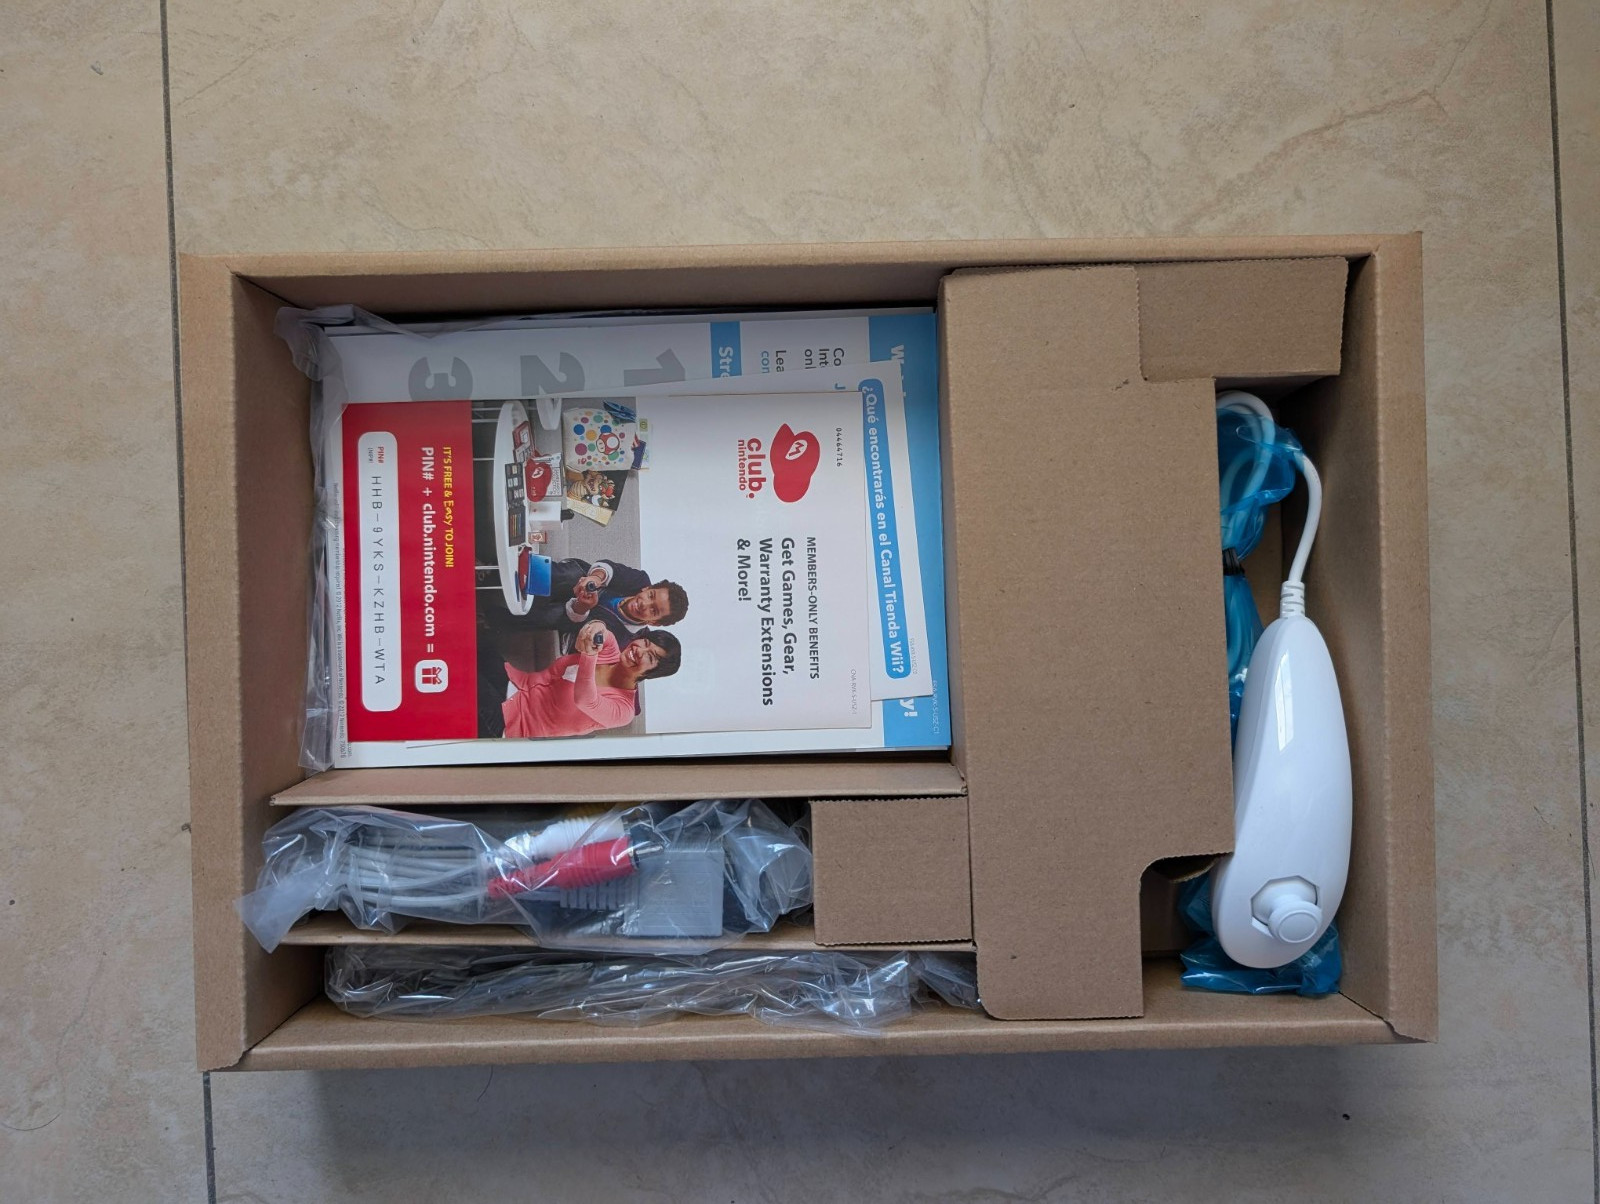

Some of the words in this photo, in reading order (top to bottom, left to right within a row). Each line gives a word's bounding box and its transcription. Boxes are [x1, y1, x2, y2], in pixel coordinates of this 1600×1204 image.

[520, 352, 585, 397] 2
[624, 349, 686, 388] 1
[819, 348, 829, 369] Int
[408, 357, 473, 402] 3
[862, 386, 879, 424] ¿Qué
[377, 446, 385, 464] PIN#
[421, 446, 434, 481] PIN#
[443, 446, 451, 464] IT'S
[737, 439, 747, 491] nintendo
[835, 427, 843, 468] 04464716
[444, 465, 452, 489] FREE
[868, 427, 886, 509] encontrarás
[422, 487, 432, 497] +
[444, 490, 452, 498] &
[443, 500, 453, 526] Easy
[877, 512, 887, 530] en
[445, 528, 453, 541] TO
[737, 538, 750, 551] &
[782, 537, 795, 566] Get
[878, 534, 890, 546] el
[422, 503, 437, 637] club.nintendo.com
[445, 542, 454, 568] JOIN!
[880, 549, 892, 588] Canal
[737, 555, 751, 602] More!
[757, 538, 773, 613] Warranty
[807, 537, 818, 624] MEMBERS-ONLY
[782, 569, 796, 630] Games,
[884, 590, 898, 638] Tienda
[761, 617, 775, 707] Extensions
[783, 632, 797, 675] Gear,
[809, 627, 819, 680] BENEFITS
[889, 641, 903, 674] Wii?
